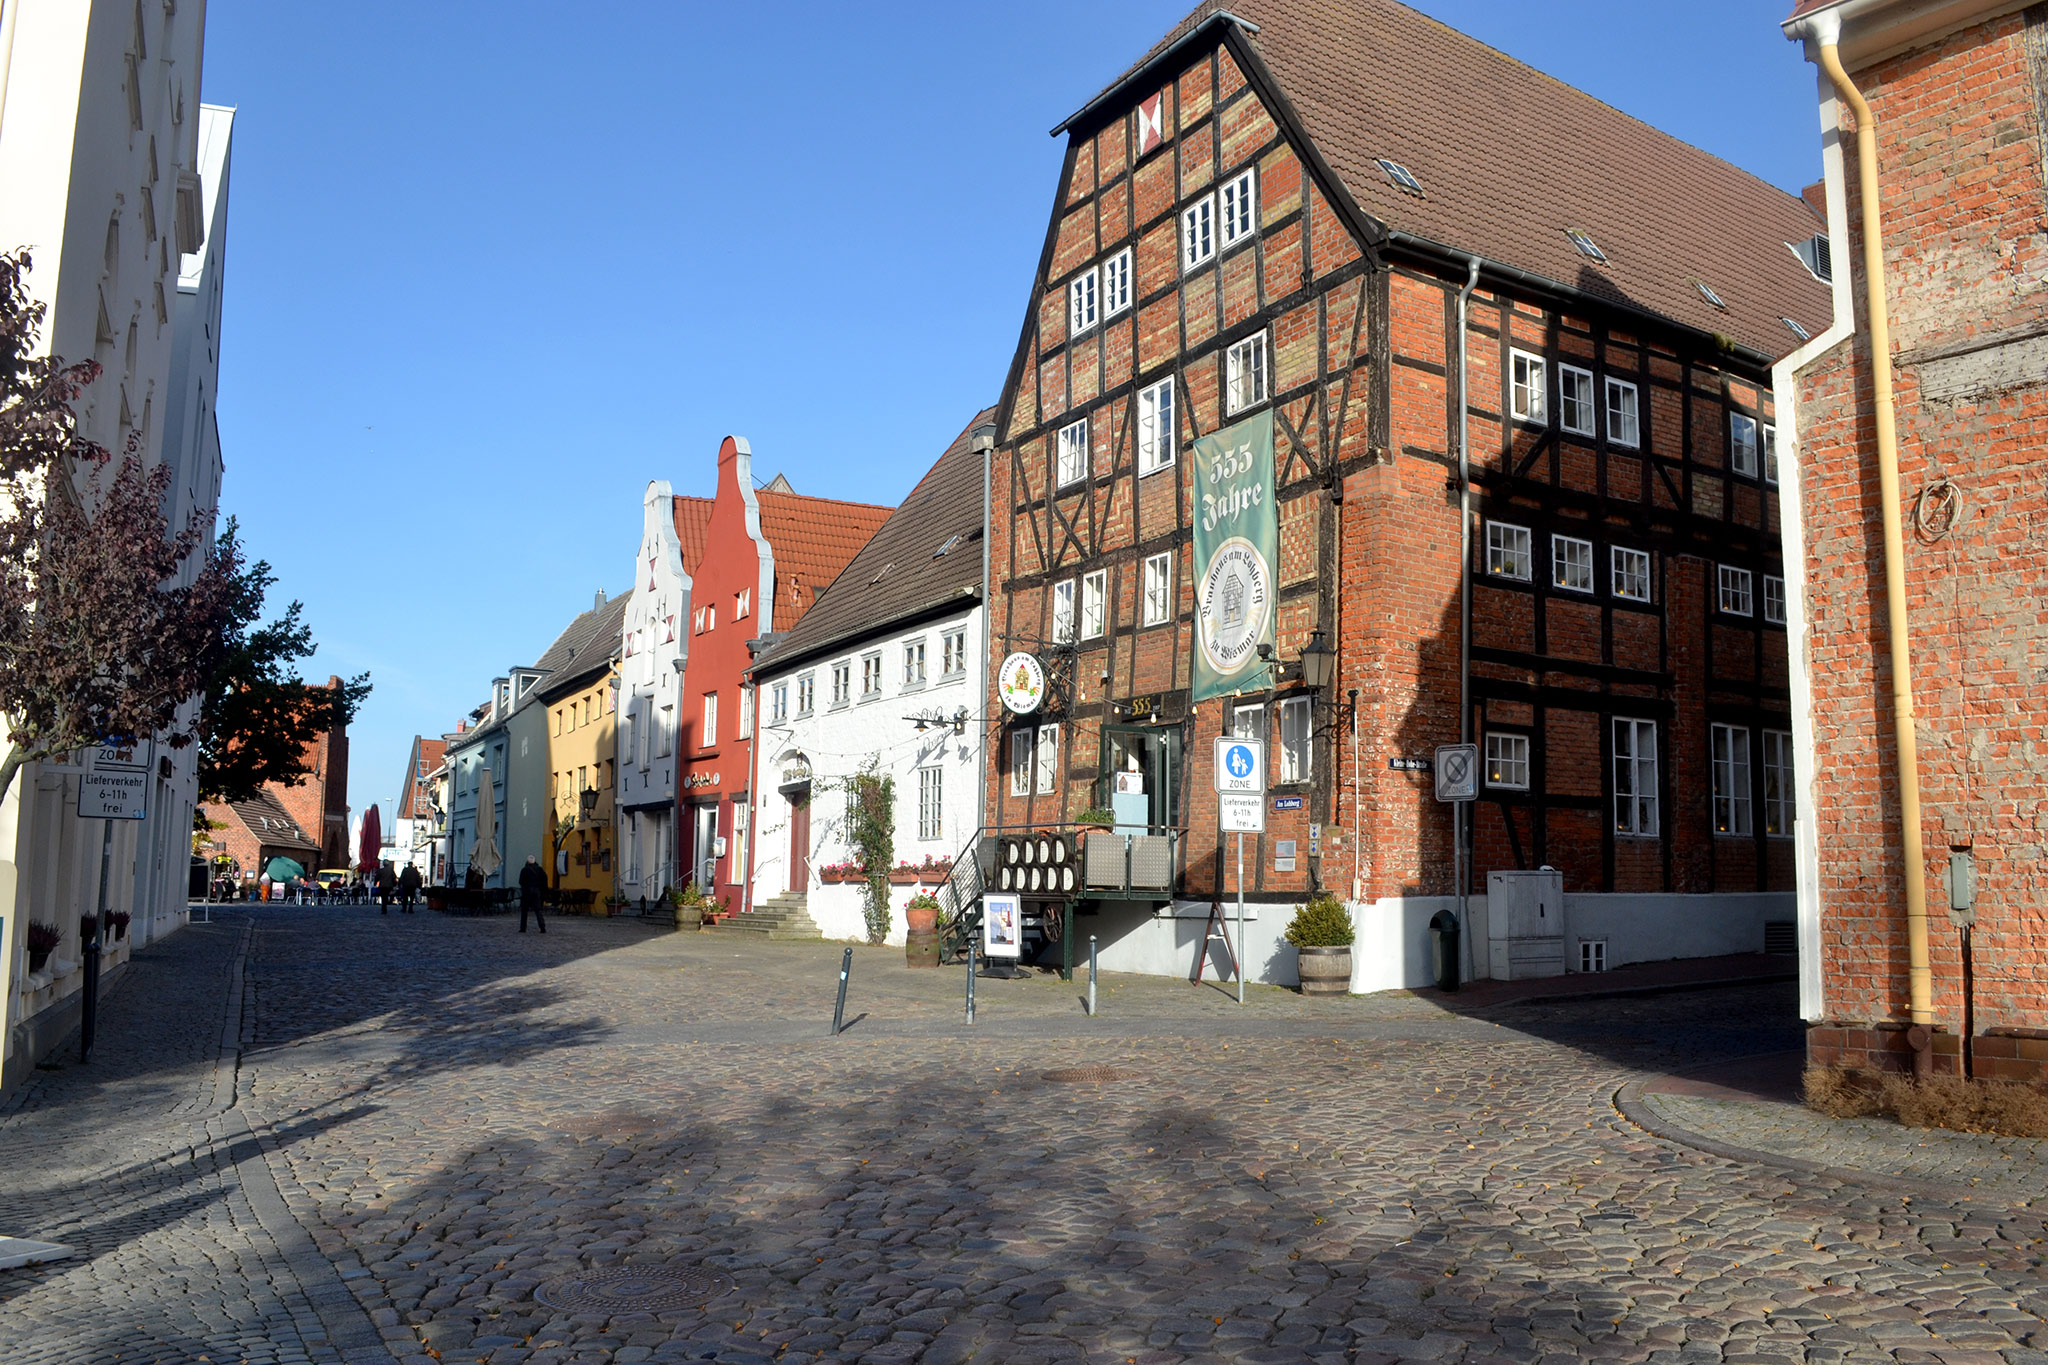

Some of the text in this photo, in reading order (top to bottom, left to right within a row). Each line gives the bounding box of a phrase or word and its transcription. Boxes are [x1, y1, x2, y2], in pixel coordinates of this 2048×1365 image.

[1210, 440, 1253, 484] 555
[1202, 482, 1262, 532] Jahre
[1202, 550, 1263, 618] Brauhaus am Lohberg
[1221, 630, 1254, 660] Wismar
[1132, 697, 1151, 716] 555
[85, 774, 143, 787] Lieferverkehr
[1229, 780, 1251, 788] ZONE
[99, 789, 127, 800] 6-11h
[1448, 786, 1465, 794] ZONE
[103, 803, 123, 813] frei
[1223, 798, 1260, 807] Lieferverkehr
